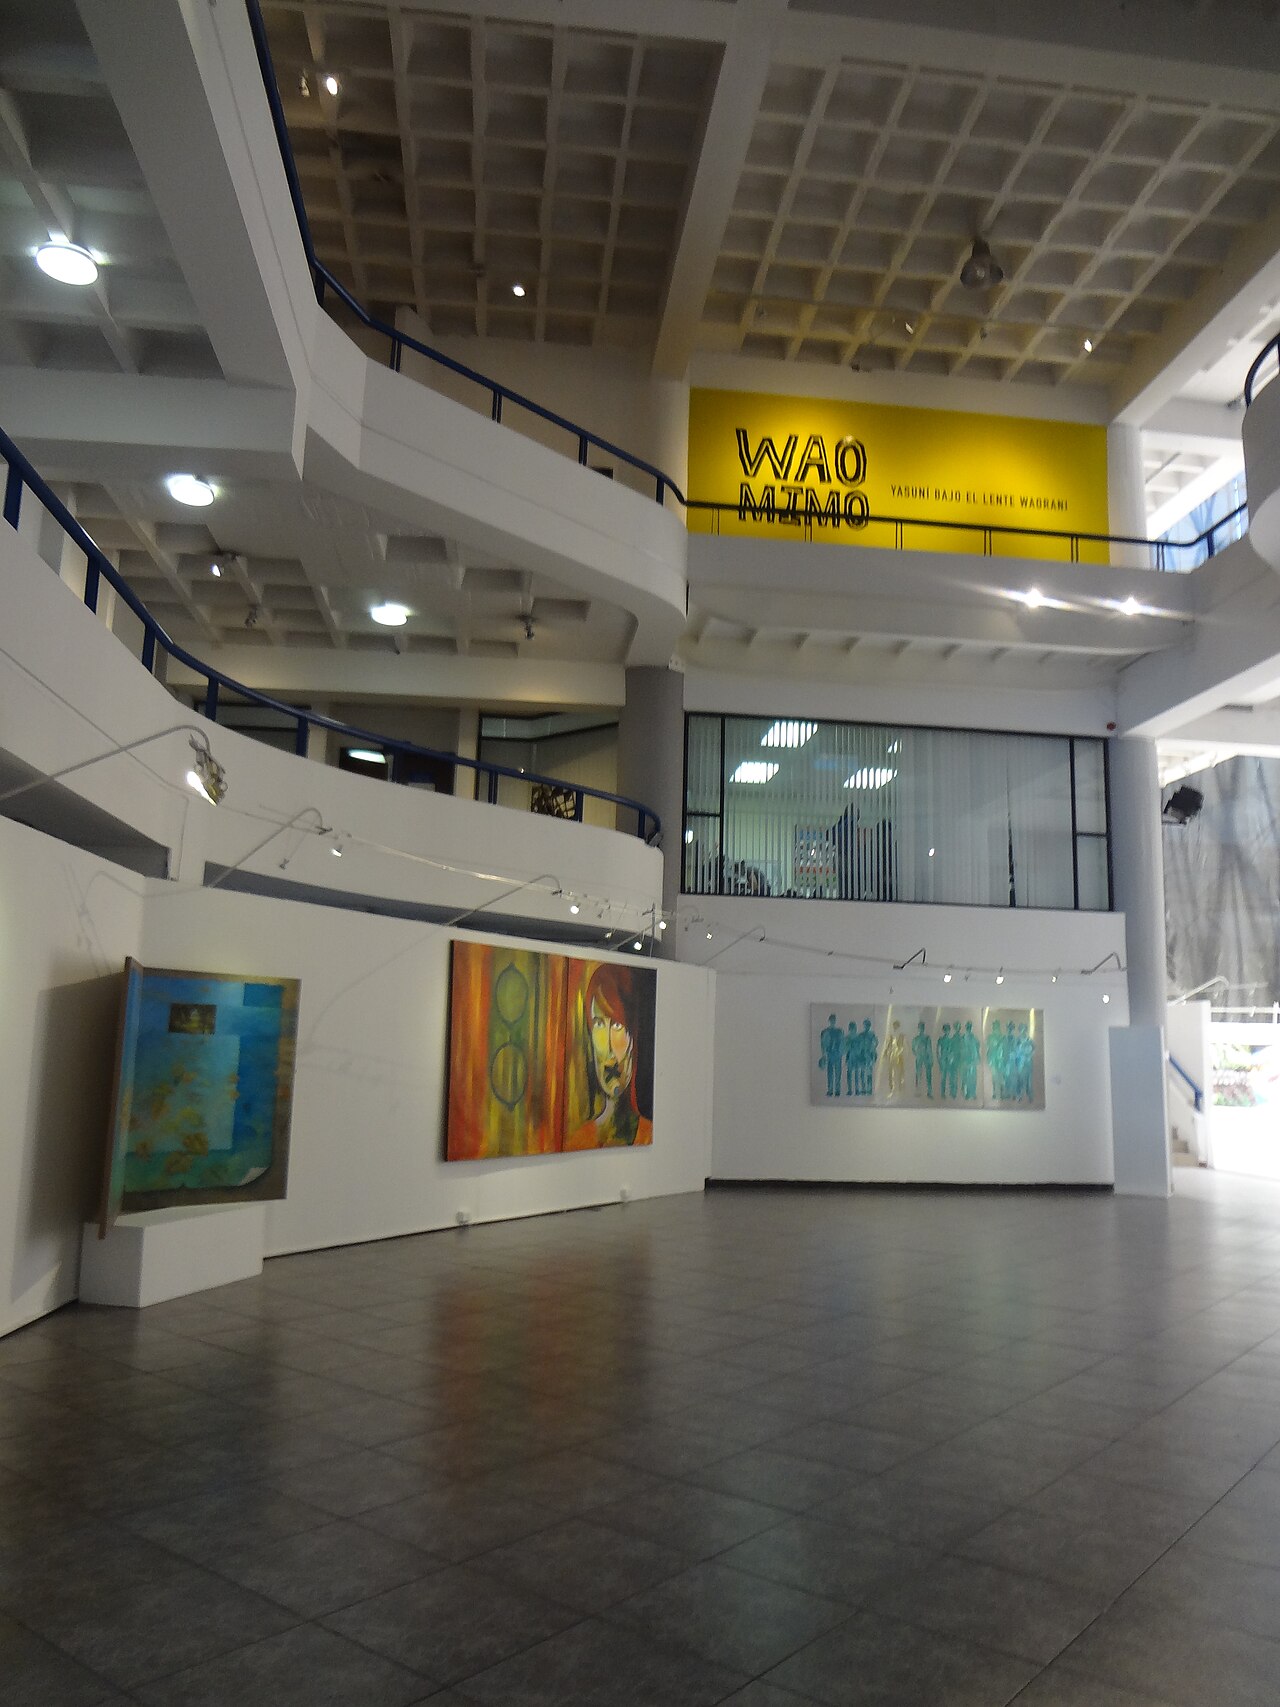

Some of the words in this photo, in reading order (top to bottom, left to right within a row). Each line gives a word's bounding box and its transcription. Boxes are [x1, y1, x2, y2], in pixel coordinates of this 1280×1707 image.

[736, 428, 867, 487] WAO
[739, 483, 870, 530] MIMO
[934, 488, 961, 502] BAJO
[966, 490, 977, 504] EL
[983, 492, 1014, 508] LENTE
